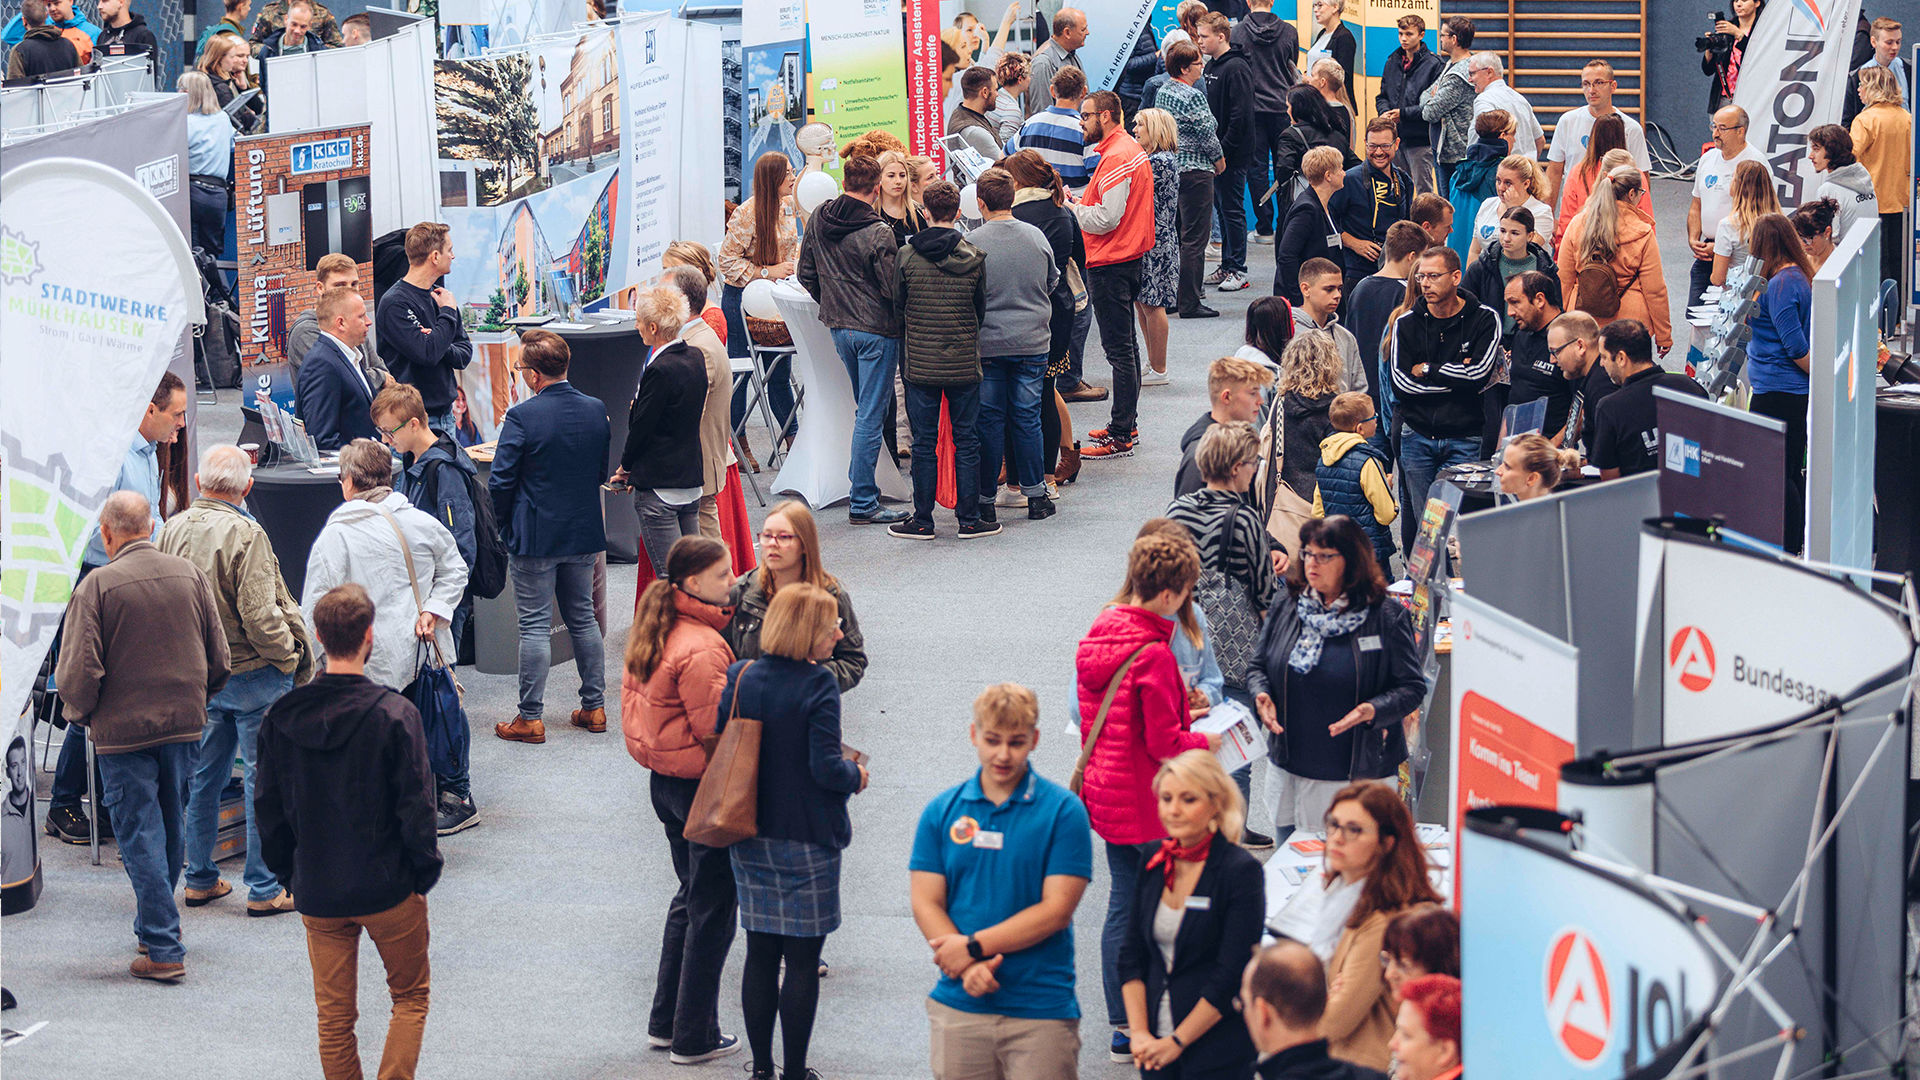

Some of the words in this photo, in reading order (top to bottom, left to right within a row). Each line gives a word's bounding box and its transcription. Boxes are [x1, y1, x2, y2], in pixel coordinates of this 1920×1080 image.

[1102, 73, 1112, 87] BE
[1126, 28, 1136, 40] BE
[926, 34, 940, 159] Fachhochschulreife
[1766, 39, 1825, 209] EATON
[313, 157, 351, 170] Kratochwil
[314, 141, 349, 158] KKT
[356, 134, 364, 168] kkt.de
[247, 149, 265, 245] Lüftung
[8, 296, 144, 339] MÜHLHAUSEN
[41, 282, 168, 322] STADTWERKE
[251, 275, 269, 343] Klima
[39, 324, 69, 341] Strom
[79, 332, 97, 345] Gas
[106, 336, 143, 353] Wärme
[1684, 443, 1700, 461] IHK
[1733, 655, 1832, 706] Bundesag
[1469, 736, 1497, 768] Komm
[1499, 751, 1512, 777] ins
[1513, 760, 1540, 791] Team!
